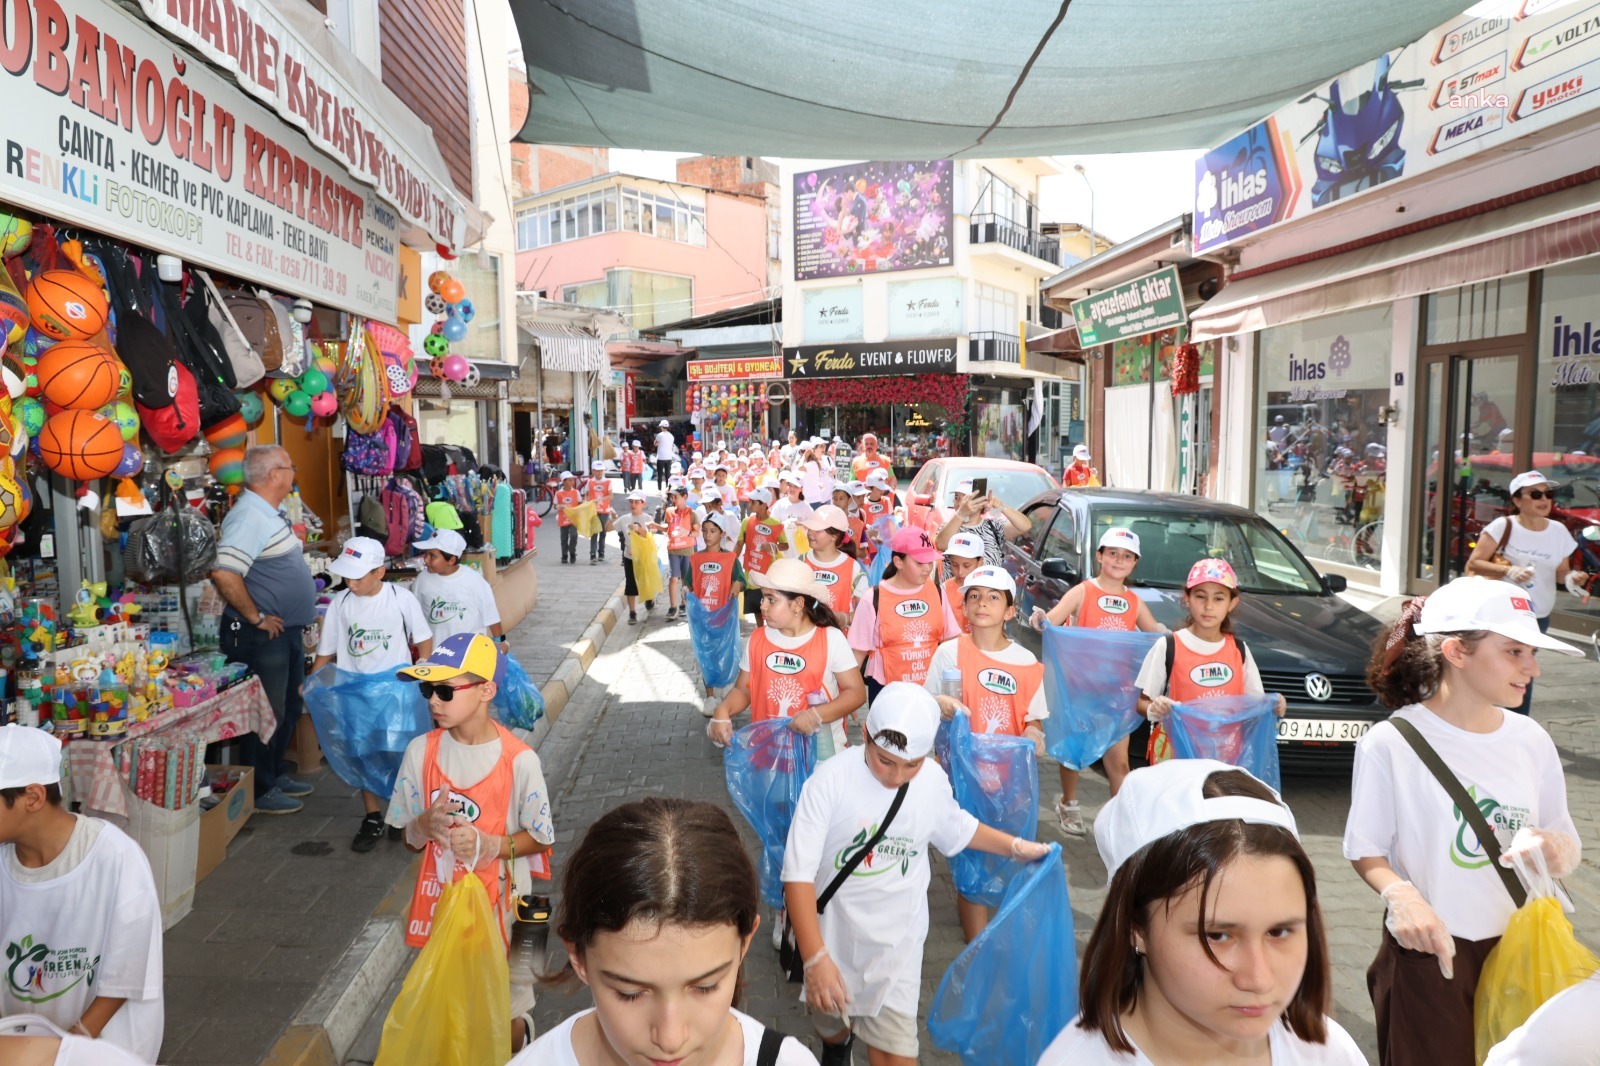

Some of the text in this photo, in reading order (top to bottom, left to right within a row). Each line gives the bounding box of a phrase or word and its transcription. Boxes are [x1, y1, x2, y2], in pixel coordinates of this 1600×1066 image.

[0, 0, 235, 183] OBANOĞLU
[1444, 115, 1483, 141] MEKA
[58, 114, 115, 172] ÇANTA
[131, 149, 179, 200] KEMER
[183, 179, 197, 207] ve
[201, 182, 224, 219] PVC
[226, 194, 274, 240] KAPLAMA
[282, 221, 307, 255] TEKEL
[1222, 197, 1273, 235] Showroom
[225, 231, 243, 260] TEL
[255, 243, 273, 271] FAX
[280, 254, 300, 279] 0256
[302, 257, 319, 287] 711
[322, 265, 335, 292] 39
[336, 273, 348, 296] 39
[1089, 279, 1140, 324] ayazefendi
[1140, 275, 1171, 304] aktar
[814, 349, 856, 371] Ferda
[860, 351, 893, 367] EVENT
[894, 351, 903, 365] &
[1551, 361, 1593, 387] Moto
[1181, 393, 1189, 495] AKTA
[815, 572, 831, 580] TEMA
[902, 602, 921, 612] TEMA
[1105, 597, 1122, 607] TEMA
[775, 655, 795, 666] TEMA
[900, 648, 930, 661] TÜRKİYE
[911, 659, 925, 673] ÇÖL
[1200, 667, 1222, 677] TEMA
[987, 671, 1011, 688] TEMA
[1279, 721, 1299, 737] 09
[1304, 722, 1335, 738] AAJ
[877, 844, 907, 856] GREEN
[43, 959, 81, 973] GREEN
[43, 971, 80, 979] FUTURE
